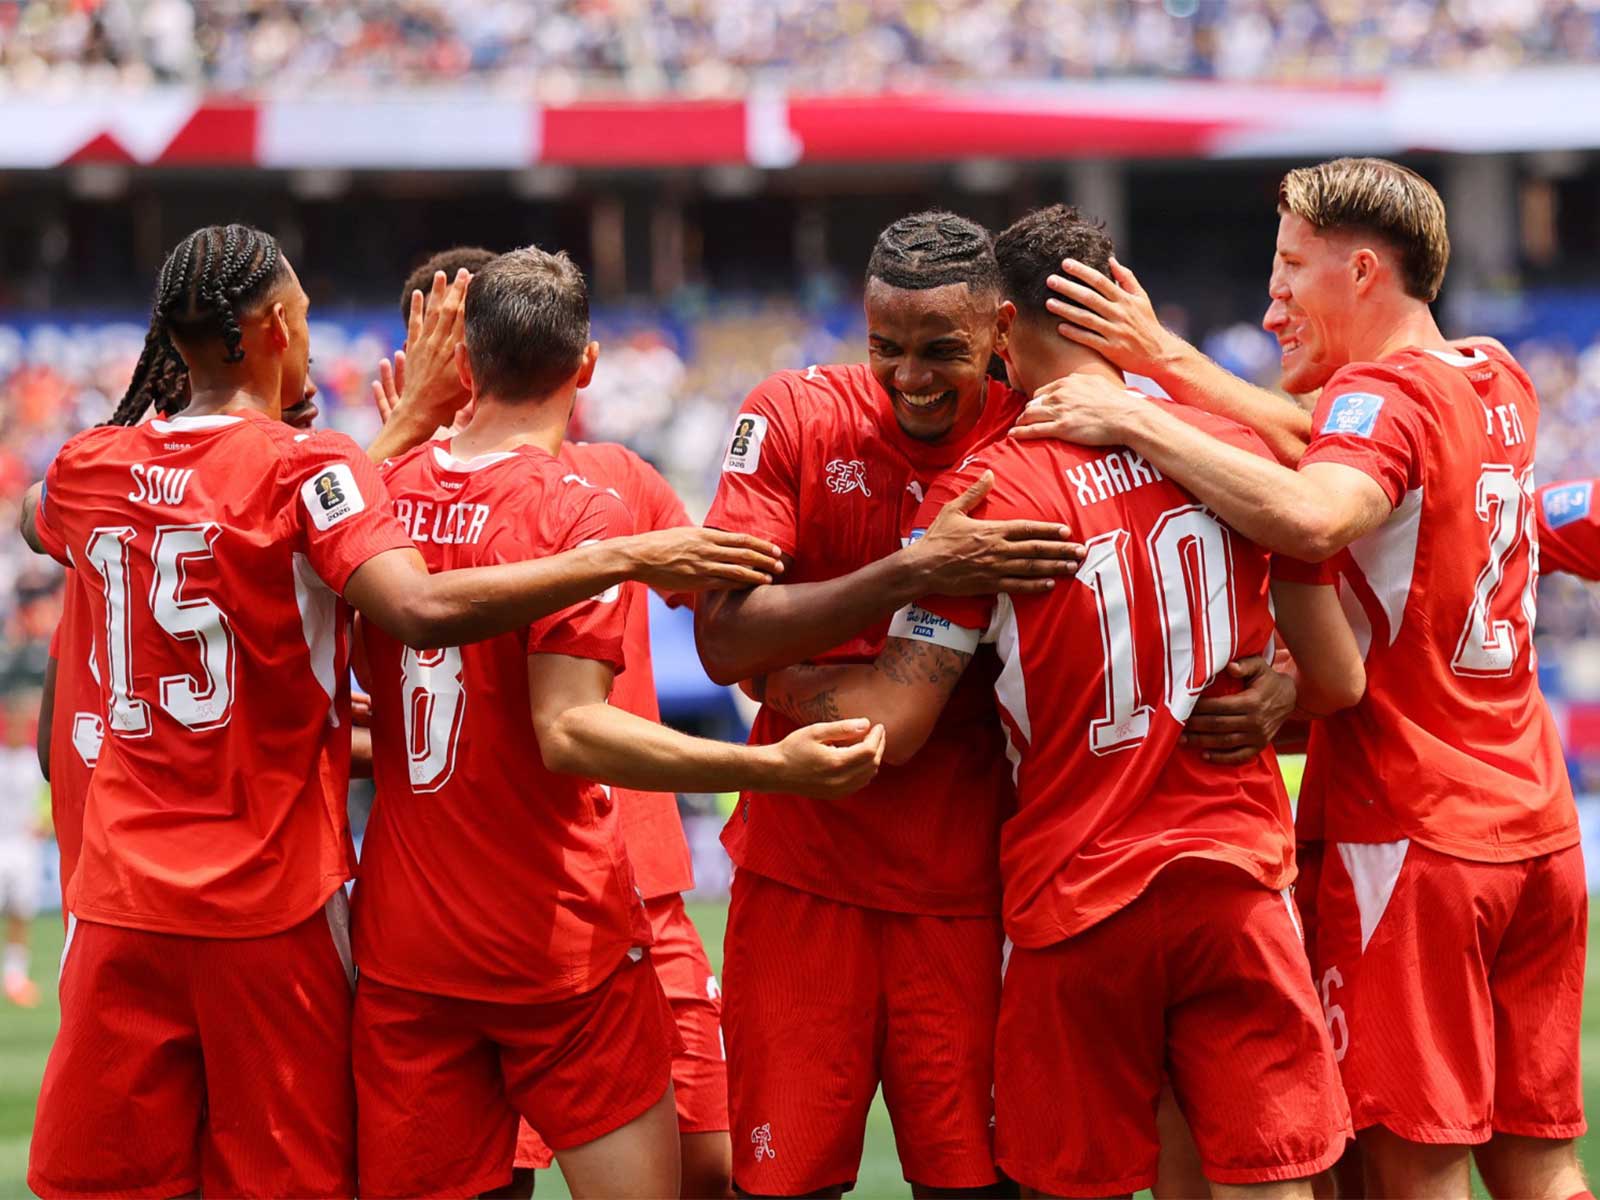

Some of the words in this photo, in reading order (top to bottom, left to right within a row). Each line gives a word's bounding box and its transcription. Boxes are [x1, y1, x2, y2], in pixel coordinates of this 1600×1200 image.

[128, 463, 194, 505] SOW
[1066, 449, 1163, 507] XHAK
[391, 498, 490, 545] REULER
[85, 522, 236, 738] 15
[914, 626, 932, 636] FIFA
[1075, 503, 1238, 756] 10
[1314, 965, 1349, 1063] 6
